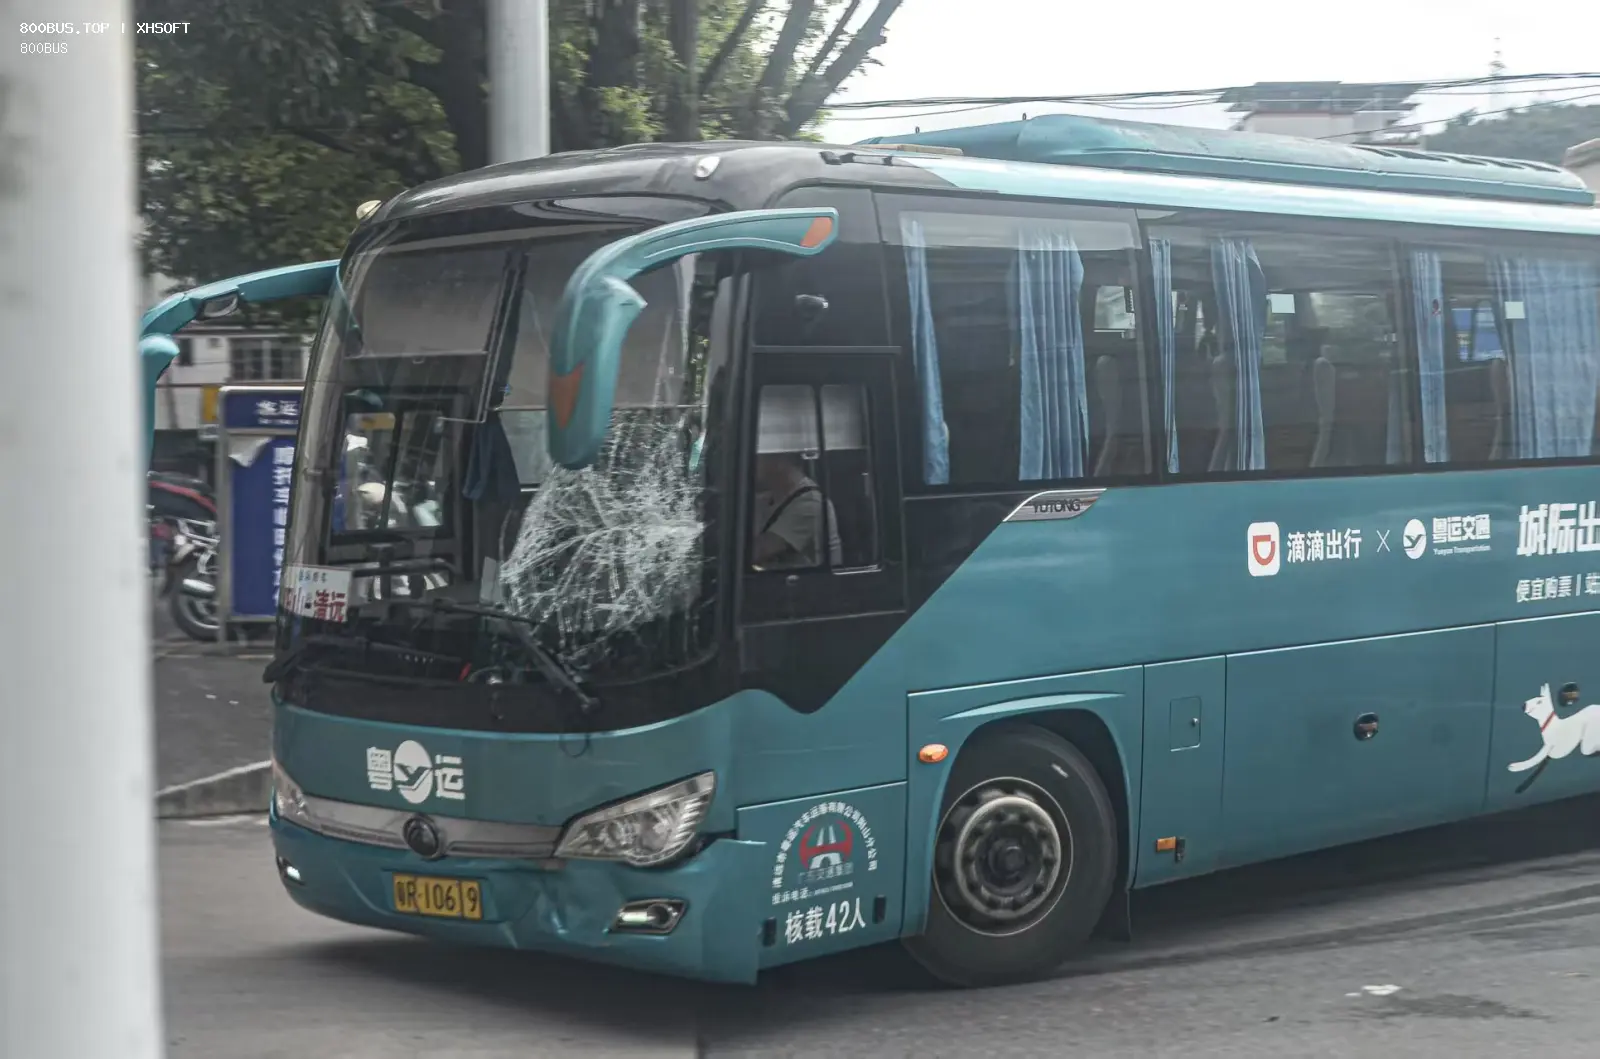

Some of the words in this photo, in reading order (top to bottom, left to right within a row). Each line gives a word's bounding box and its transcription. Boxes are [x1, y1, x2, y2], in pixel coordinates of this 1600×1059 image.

[1034, 499, 1081, 513] YUTONG
[1286, 527, 1362, 563] 滴滴出行
[1432, 513, 1491, 544] 粤运交通
[1516, 575, 1573, 603] 便宜购票
[785, 897, 866, 944] 核载42人
